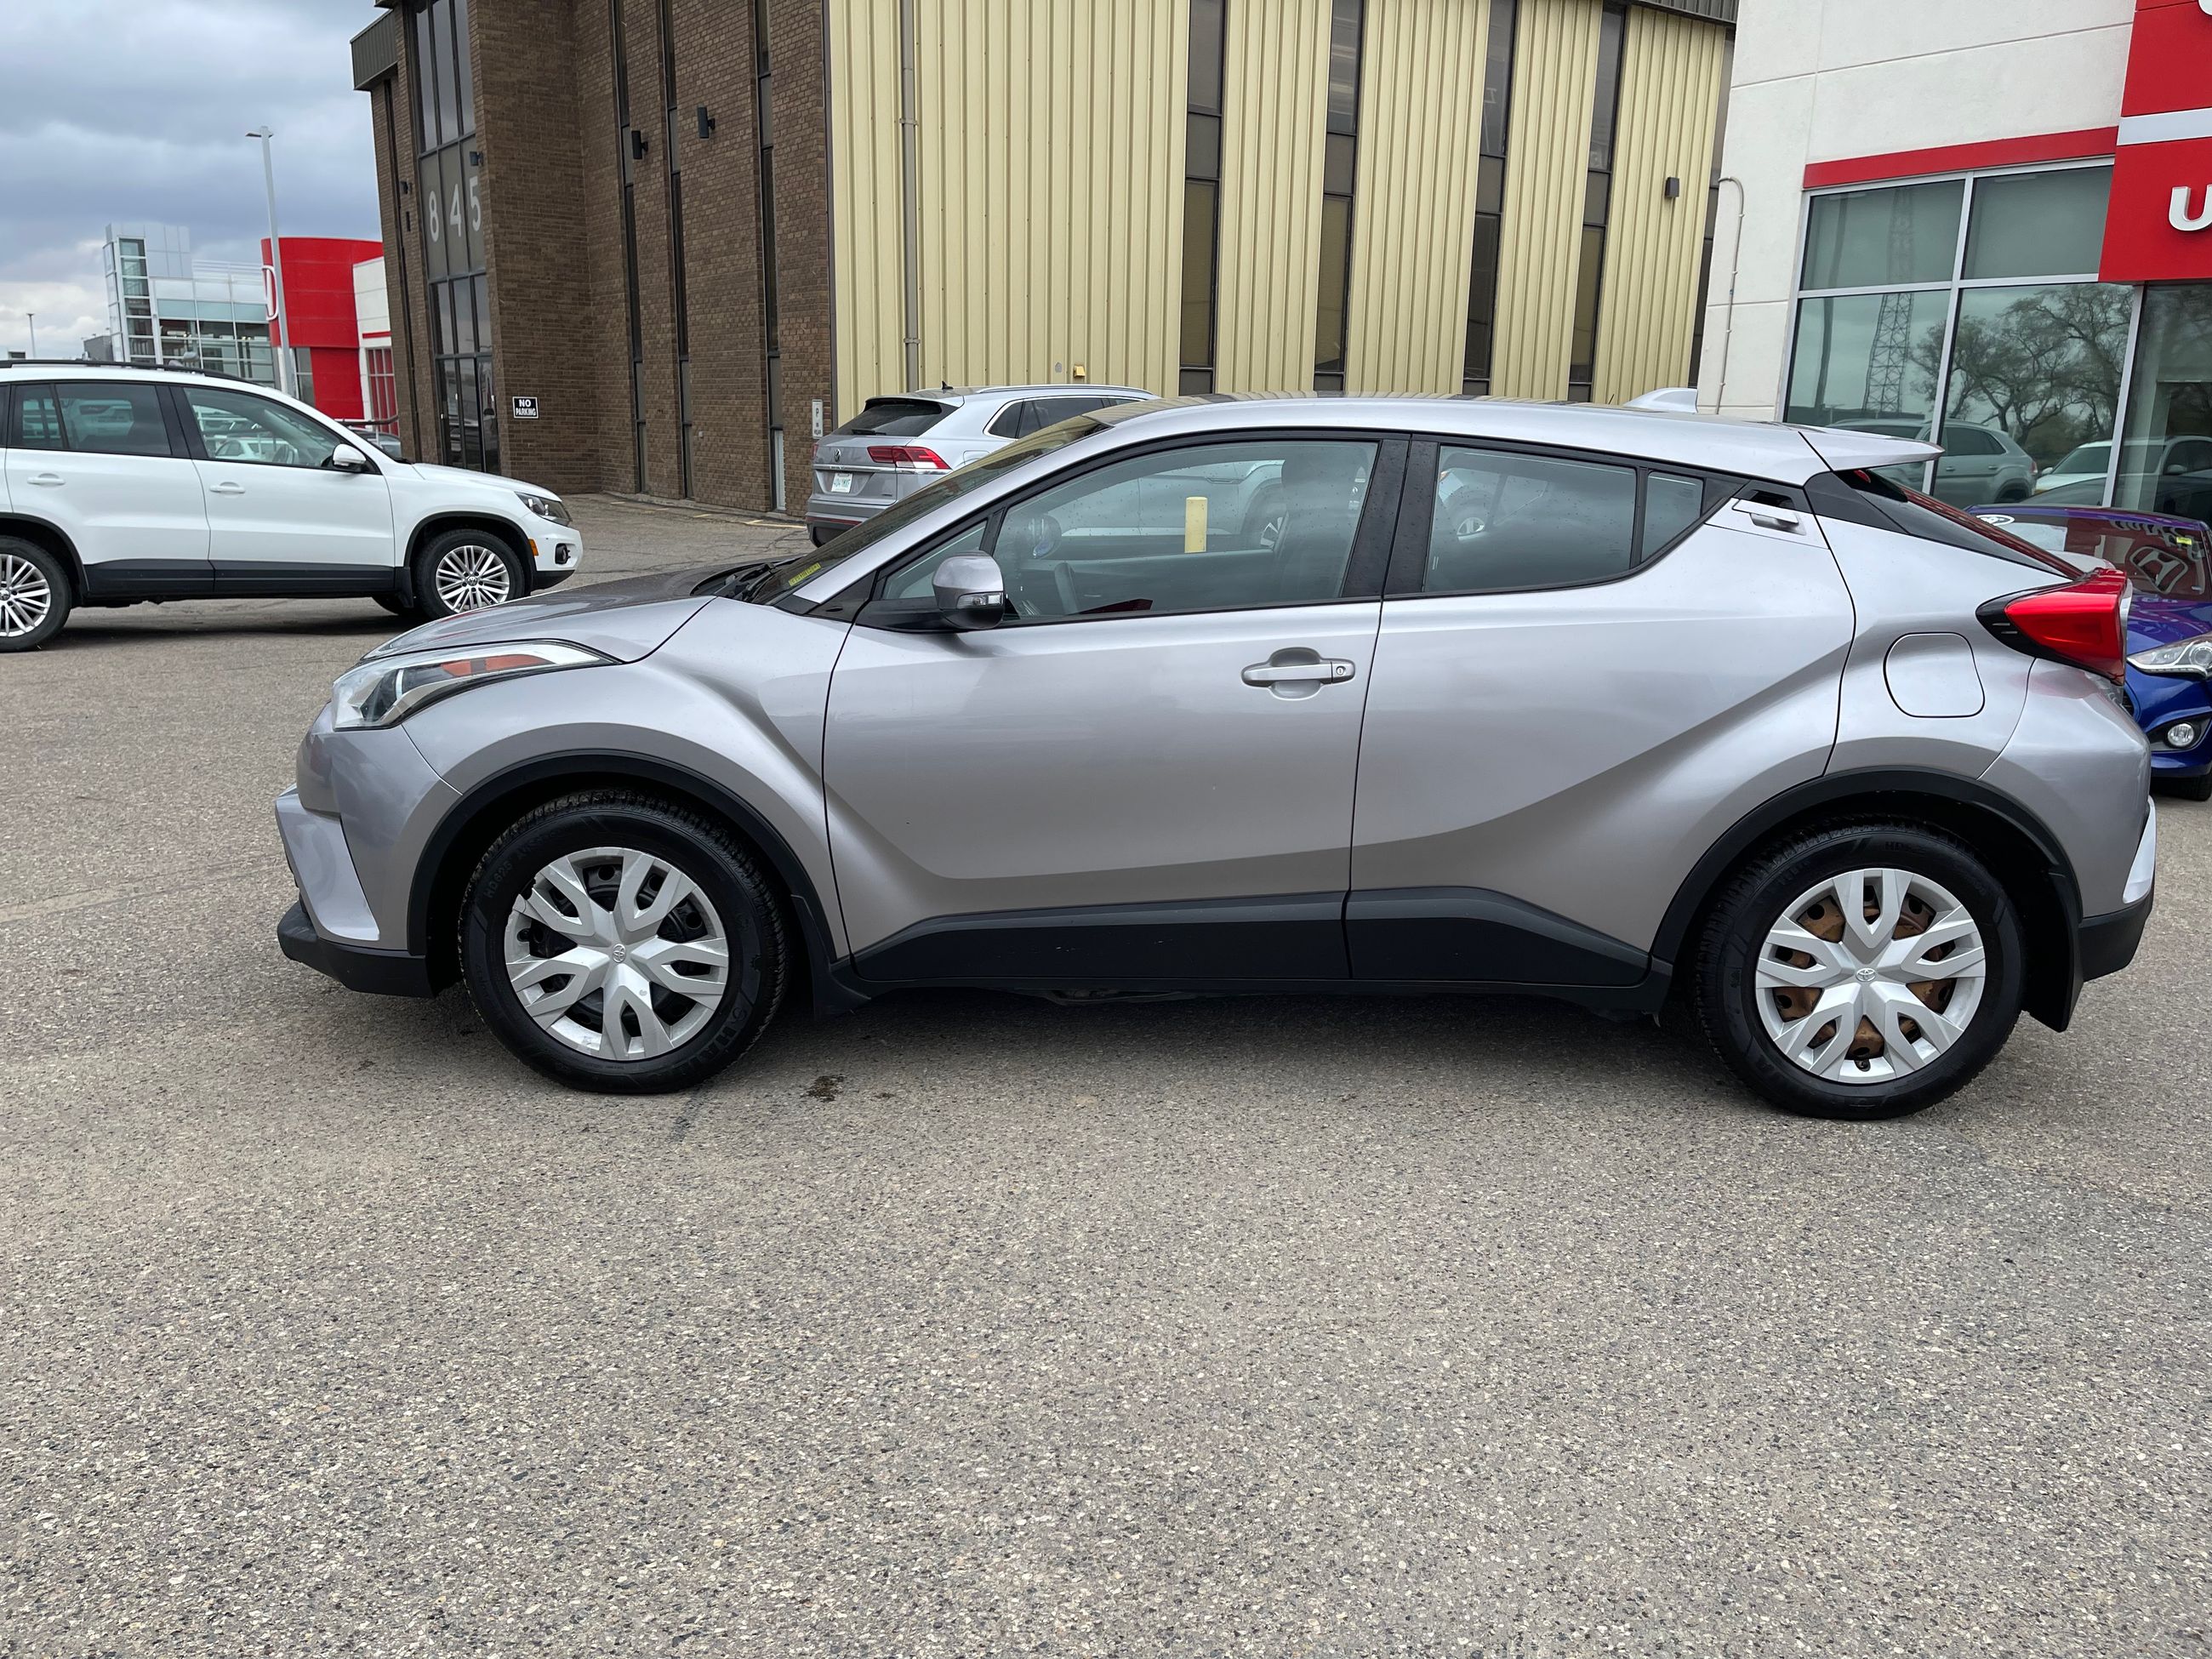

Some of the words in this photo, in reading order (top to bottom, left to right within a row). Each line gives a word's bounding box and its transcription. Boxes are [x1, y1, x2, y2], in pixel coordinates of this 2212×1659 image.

[429, 175, 482, 242] 845
[518, 399, 532, 408] NO
[515, 408, 537, 417] PARKING
